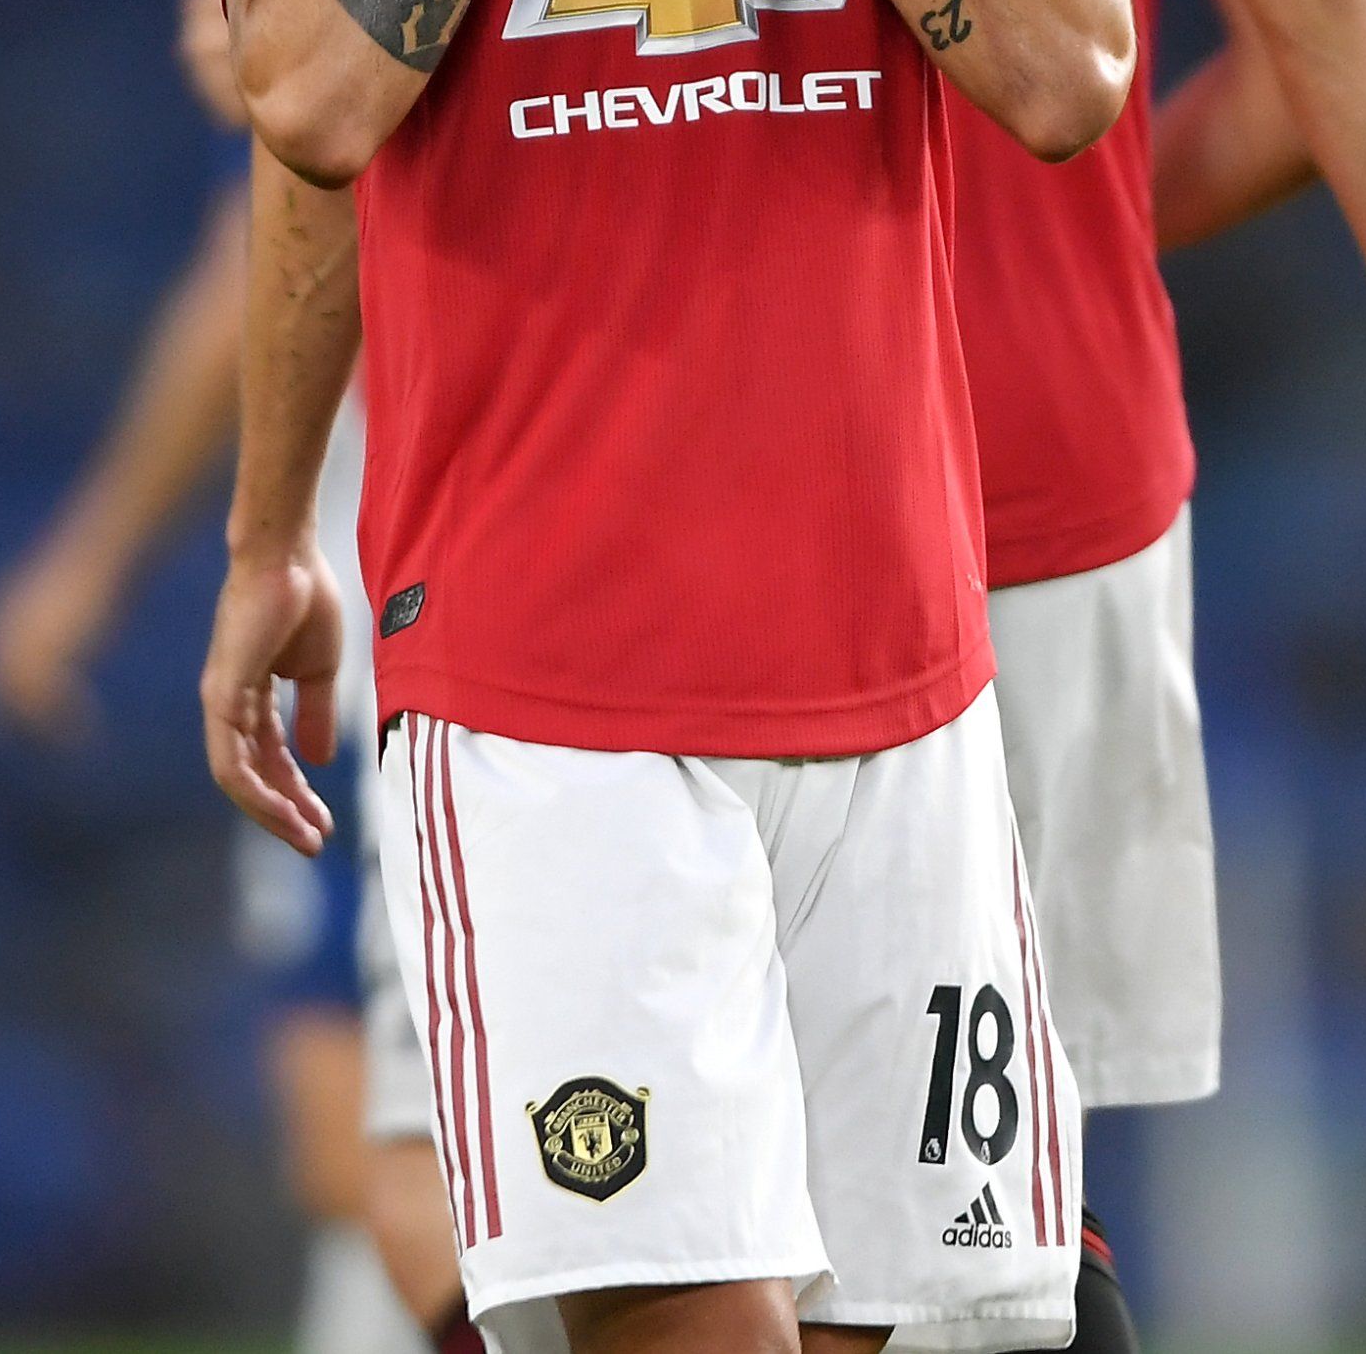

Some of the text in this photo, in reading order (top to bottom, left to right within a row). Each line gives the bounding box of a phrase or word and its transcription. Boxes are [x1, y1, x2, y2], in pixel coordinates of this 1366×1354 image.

[509, 70, 882, 139] CHEVROLET
[918, 982, 1020, 1166] 18
[942, 1222, 1013, 1249] adidas
